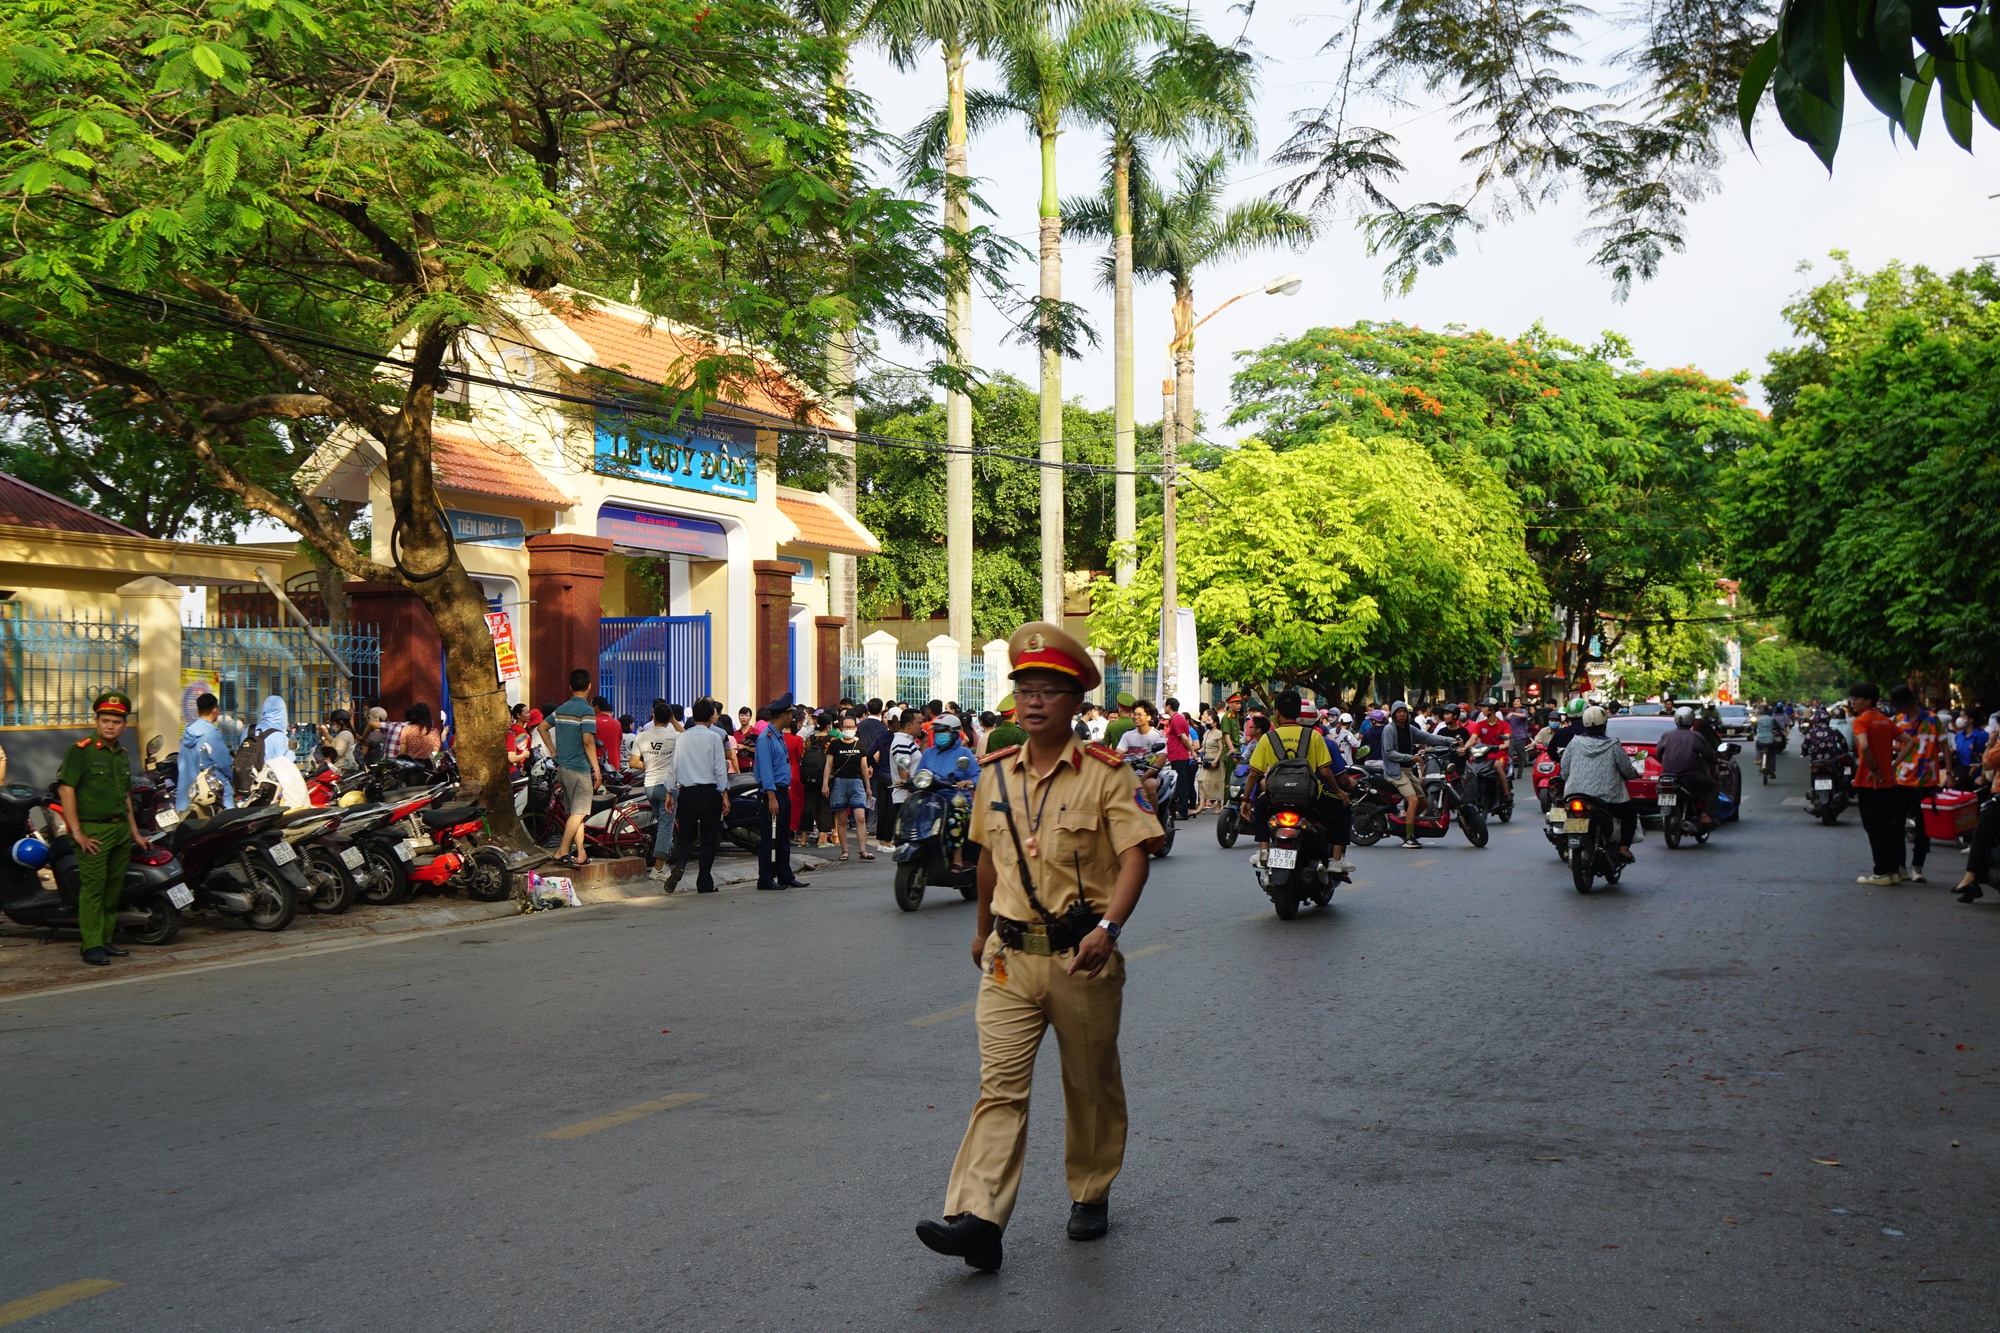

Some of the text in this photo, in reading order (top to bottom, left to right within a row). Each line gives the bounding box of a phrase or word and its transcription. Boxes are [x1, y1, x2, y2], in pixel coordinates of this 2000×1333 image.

[645, 437, 696, 476] QUÝ
[700, 444, 748, 485] ĐÔN
[457, 517, 477, 535] TIÊN
[1273, 850, 1294, 859] 15-B2
[1268, 858, 1295, 867] 952.50
